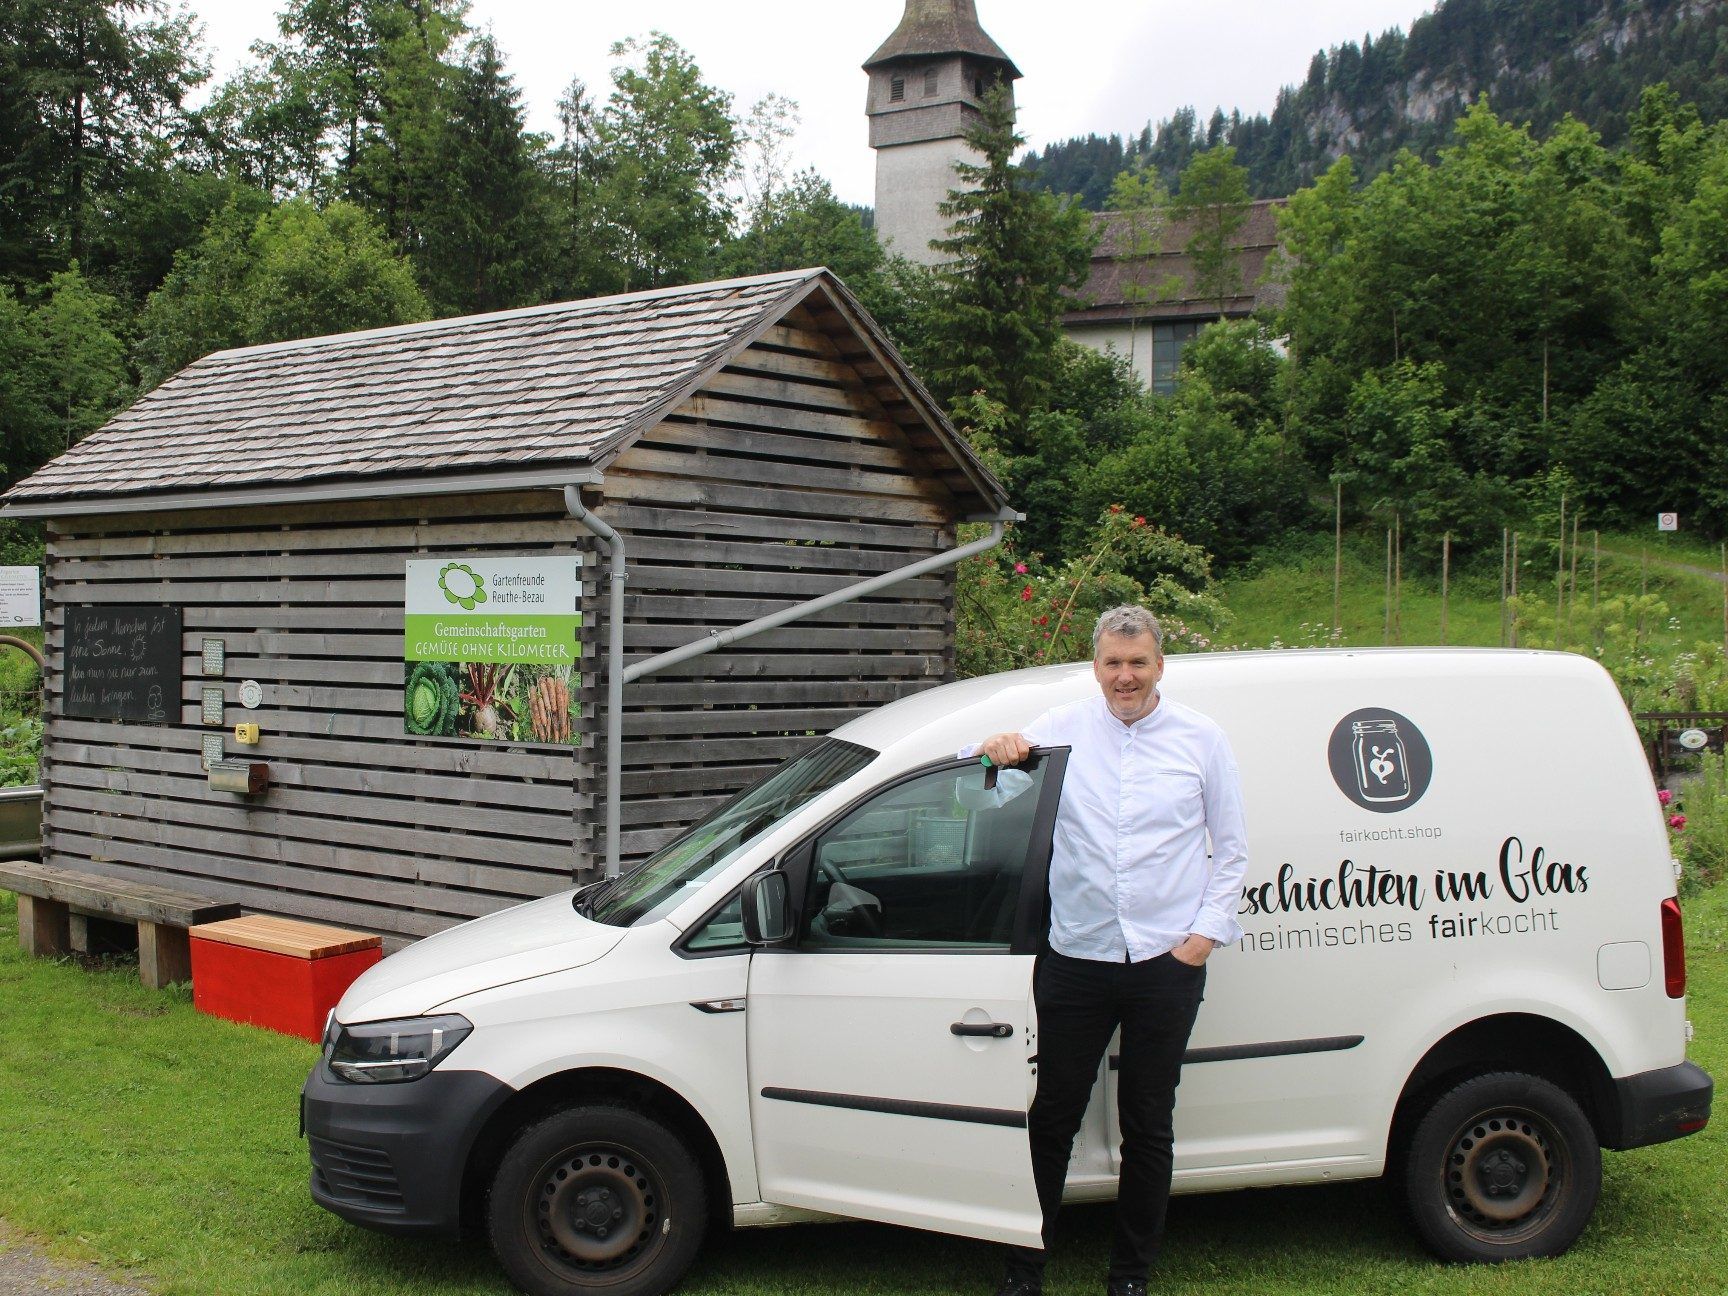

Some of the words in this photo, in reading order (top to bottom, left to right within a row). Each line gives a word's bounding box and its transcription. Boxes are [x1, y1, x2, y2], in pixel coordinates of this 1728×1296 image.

[492, 573, 545, 587] Gartenfreunde
[492, 591, 545, 604] Reuthe-Bezau
[434, 622, 547, 642] Gemeinschaftsgarten
[415, 641, 458, 656] GEMÜSE
[462, 643, 493, 657] OHNE
[497, 643, 570, 659] KILOMETER
[1339, 825, 1442, 844] fairkocht.shop
[1238, 859, 1425, 915] schichten
[1435, 868, 1494, 902] im
[1499, 836, 1590, 904] Glas
[1428, 907, 1559, 939] fairkocht
